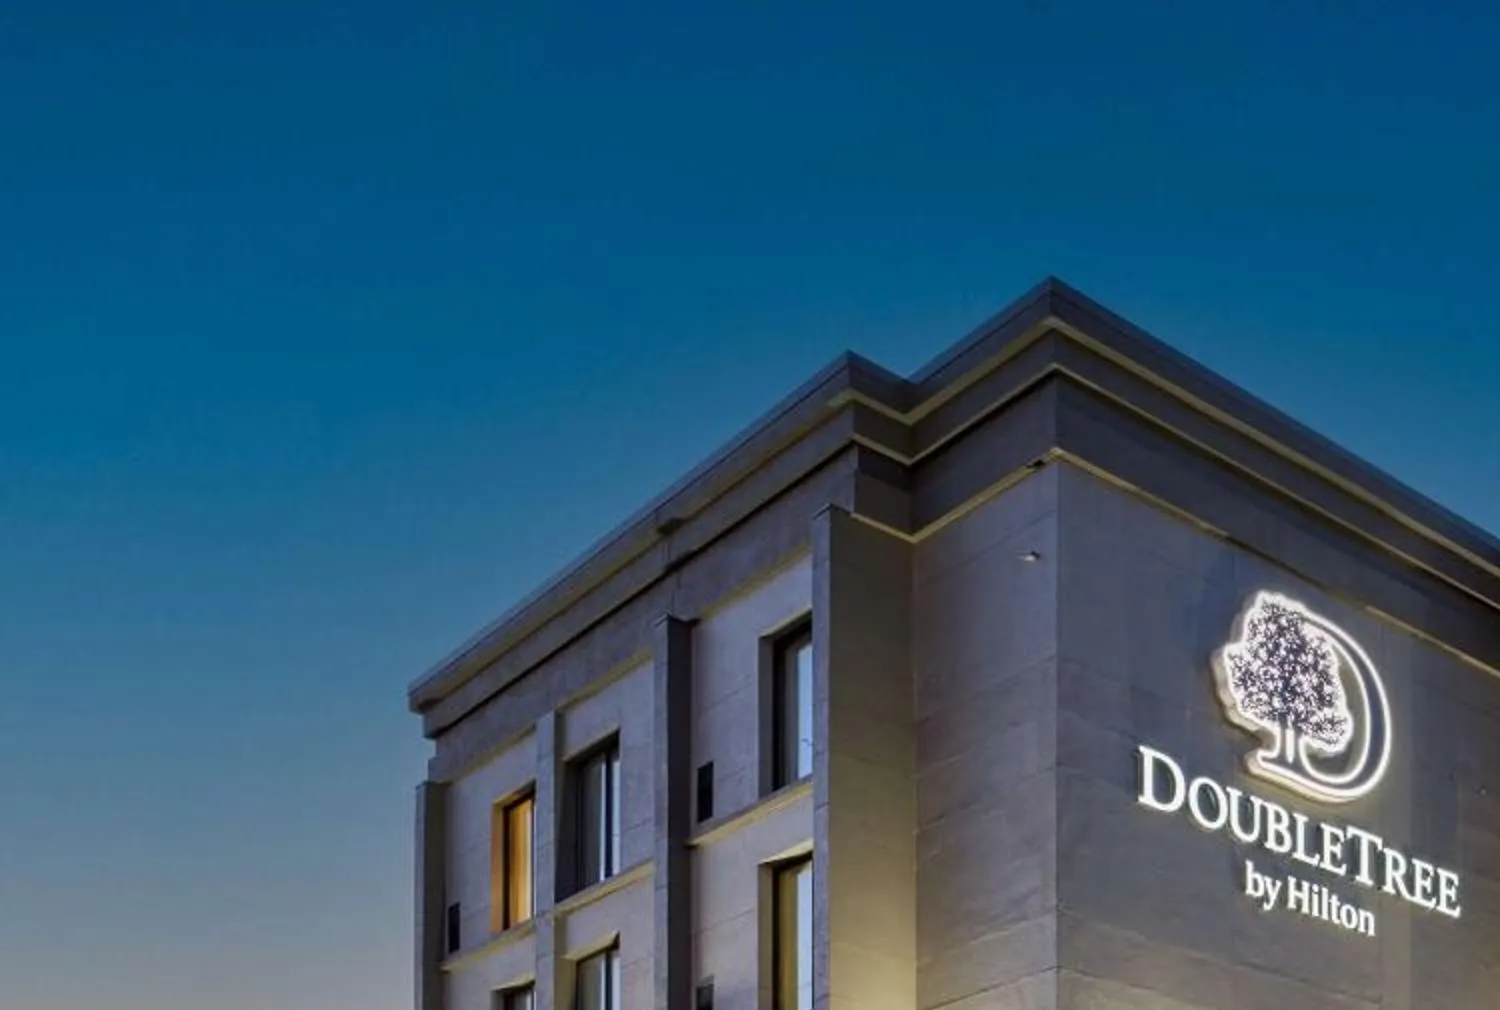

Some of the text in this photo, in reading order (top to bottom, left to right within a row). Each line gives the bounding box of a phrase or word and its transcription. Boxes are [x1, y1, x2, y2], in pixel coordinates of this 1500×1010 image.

[1138, 745, 1461, 918] DOUBLETREE
[1245, 860, 1376, 937] by Hilton
